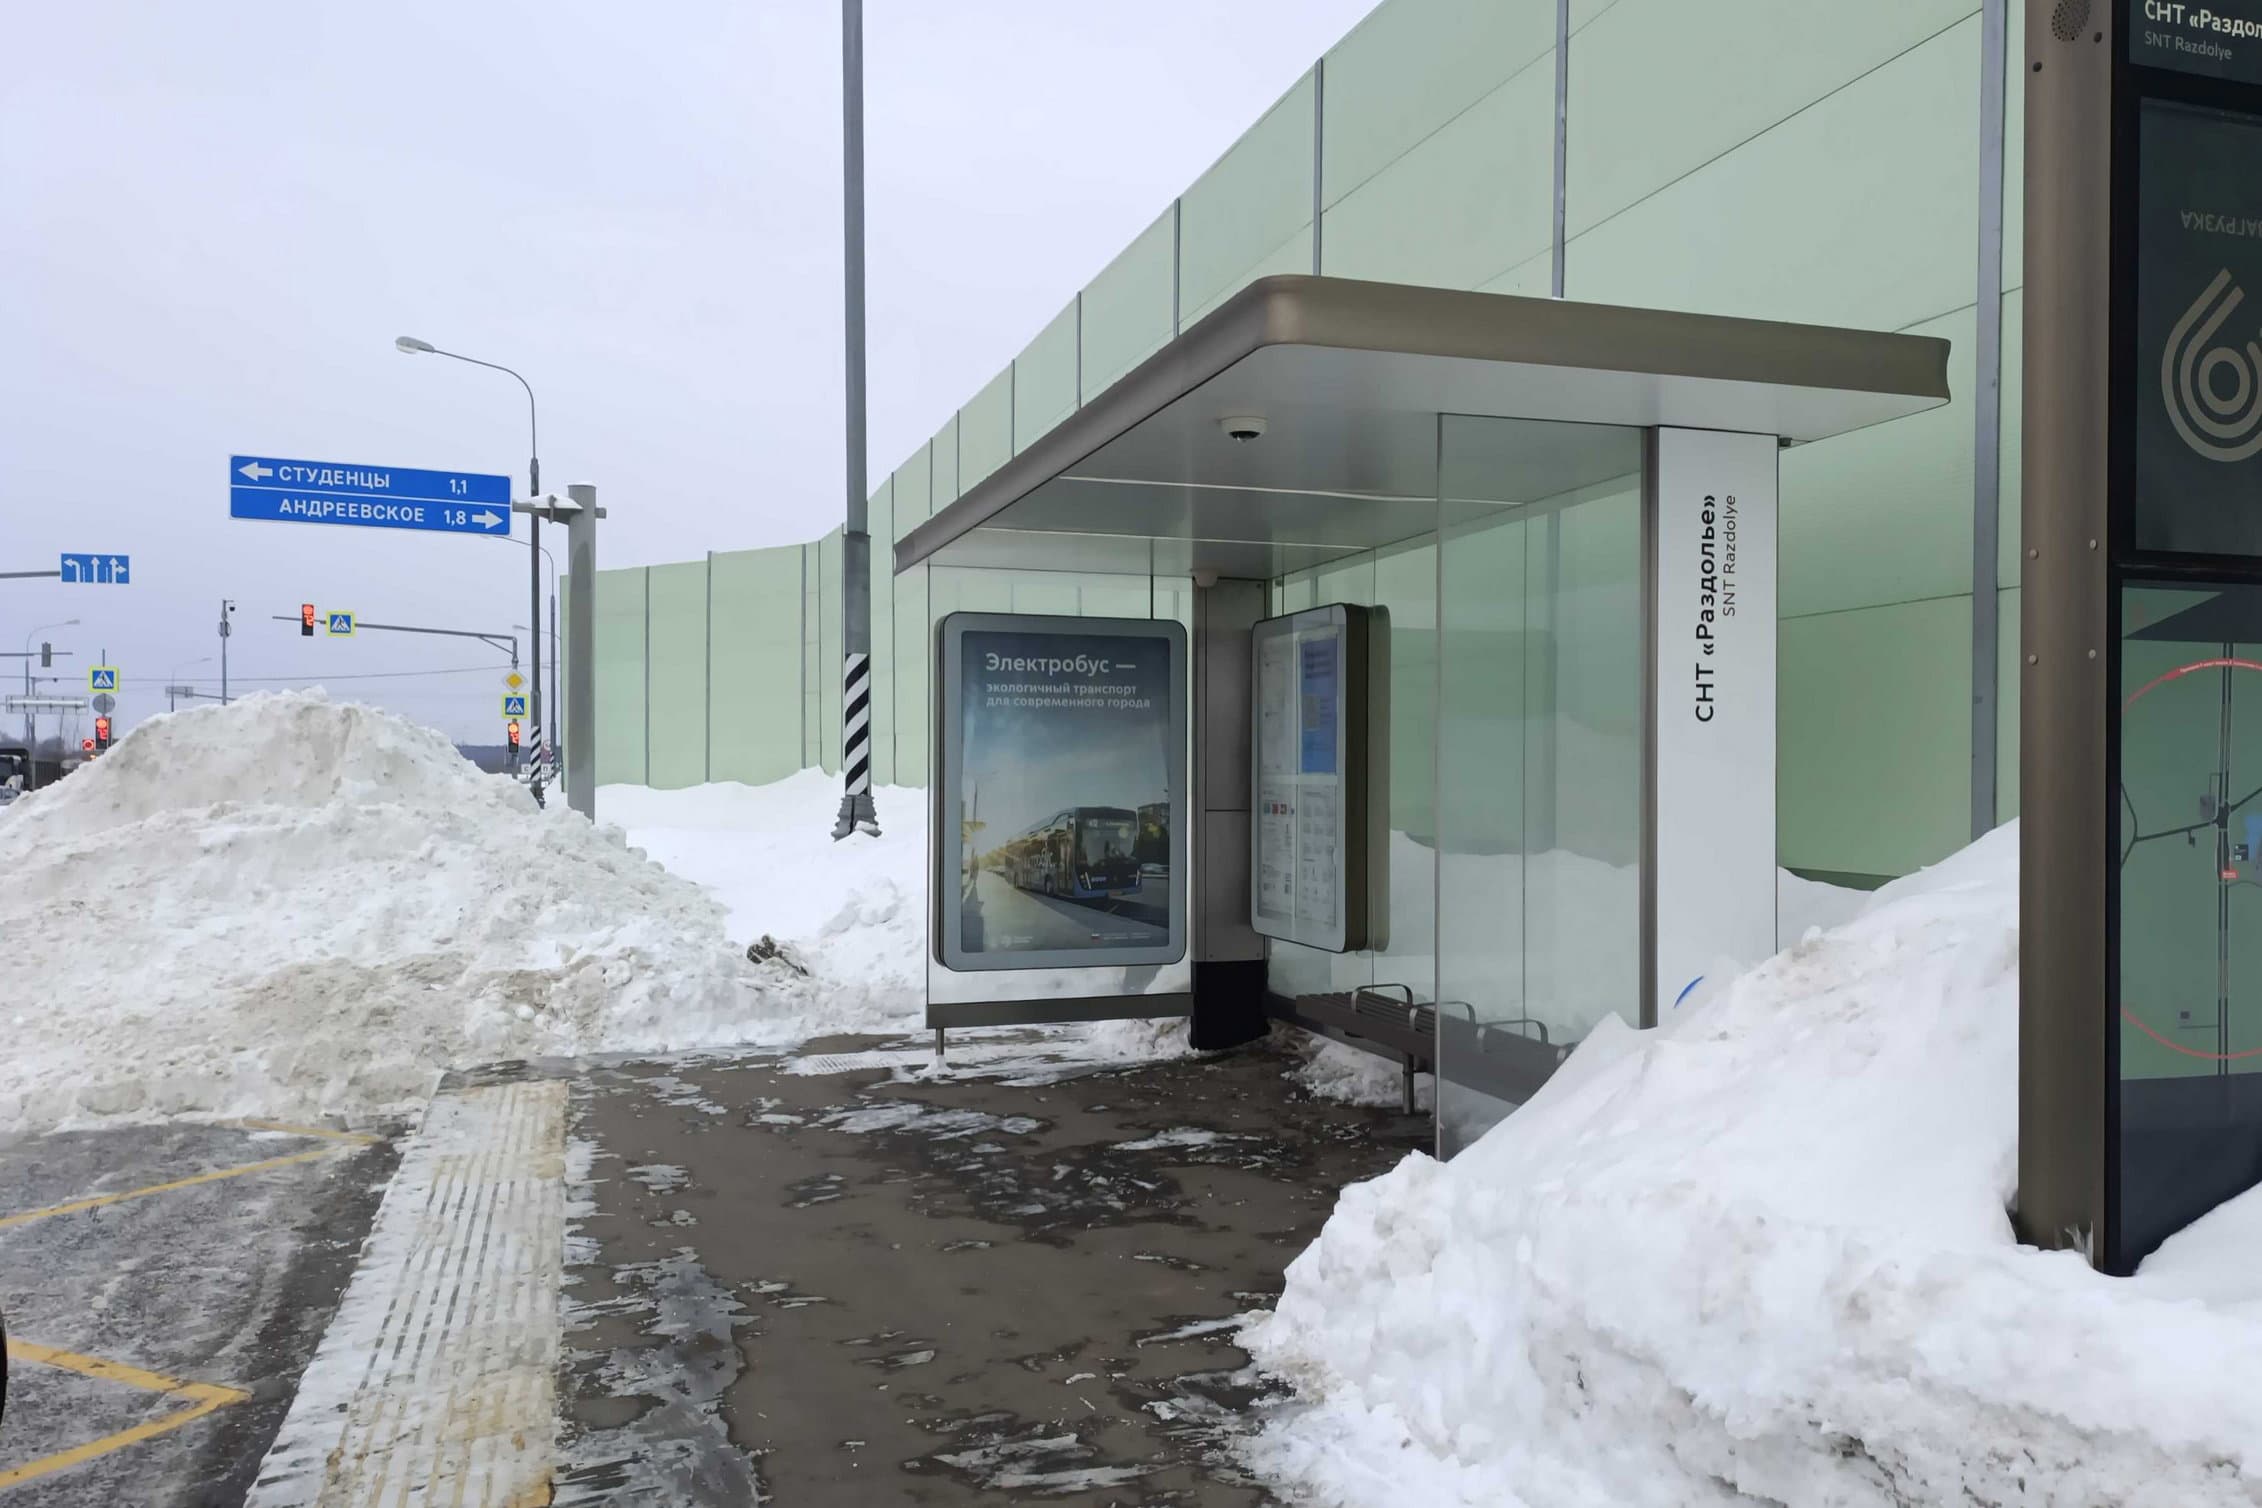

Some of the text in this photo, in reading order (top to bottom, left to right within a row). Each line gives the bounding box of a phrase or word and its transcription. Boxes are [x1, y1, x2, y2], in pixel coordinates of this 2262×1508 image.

[2144, 0, 2186, 25] СНТ
[2144, 30, 2233, 61] SNT Razdolye
[2180, 207, 2262, 238] АГРУЗКА
[278, 465, 467, 495] СТУДЕНЦЫ 1,1
[279, 498, 466, 526] АНДРЕЕВСКОЕ 1,8
[1722, 494, 1739, 617] SNT Razdolye
[1695, 494, 1718, 722] СНТ «Раздолье»
[985, 652, 1110, 677] Электробус
[986, 682, 1137, 697] экологичный транспорт
[986, 696, 1152, 710] для современного города
